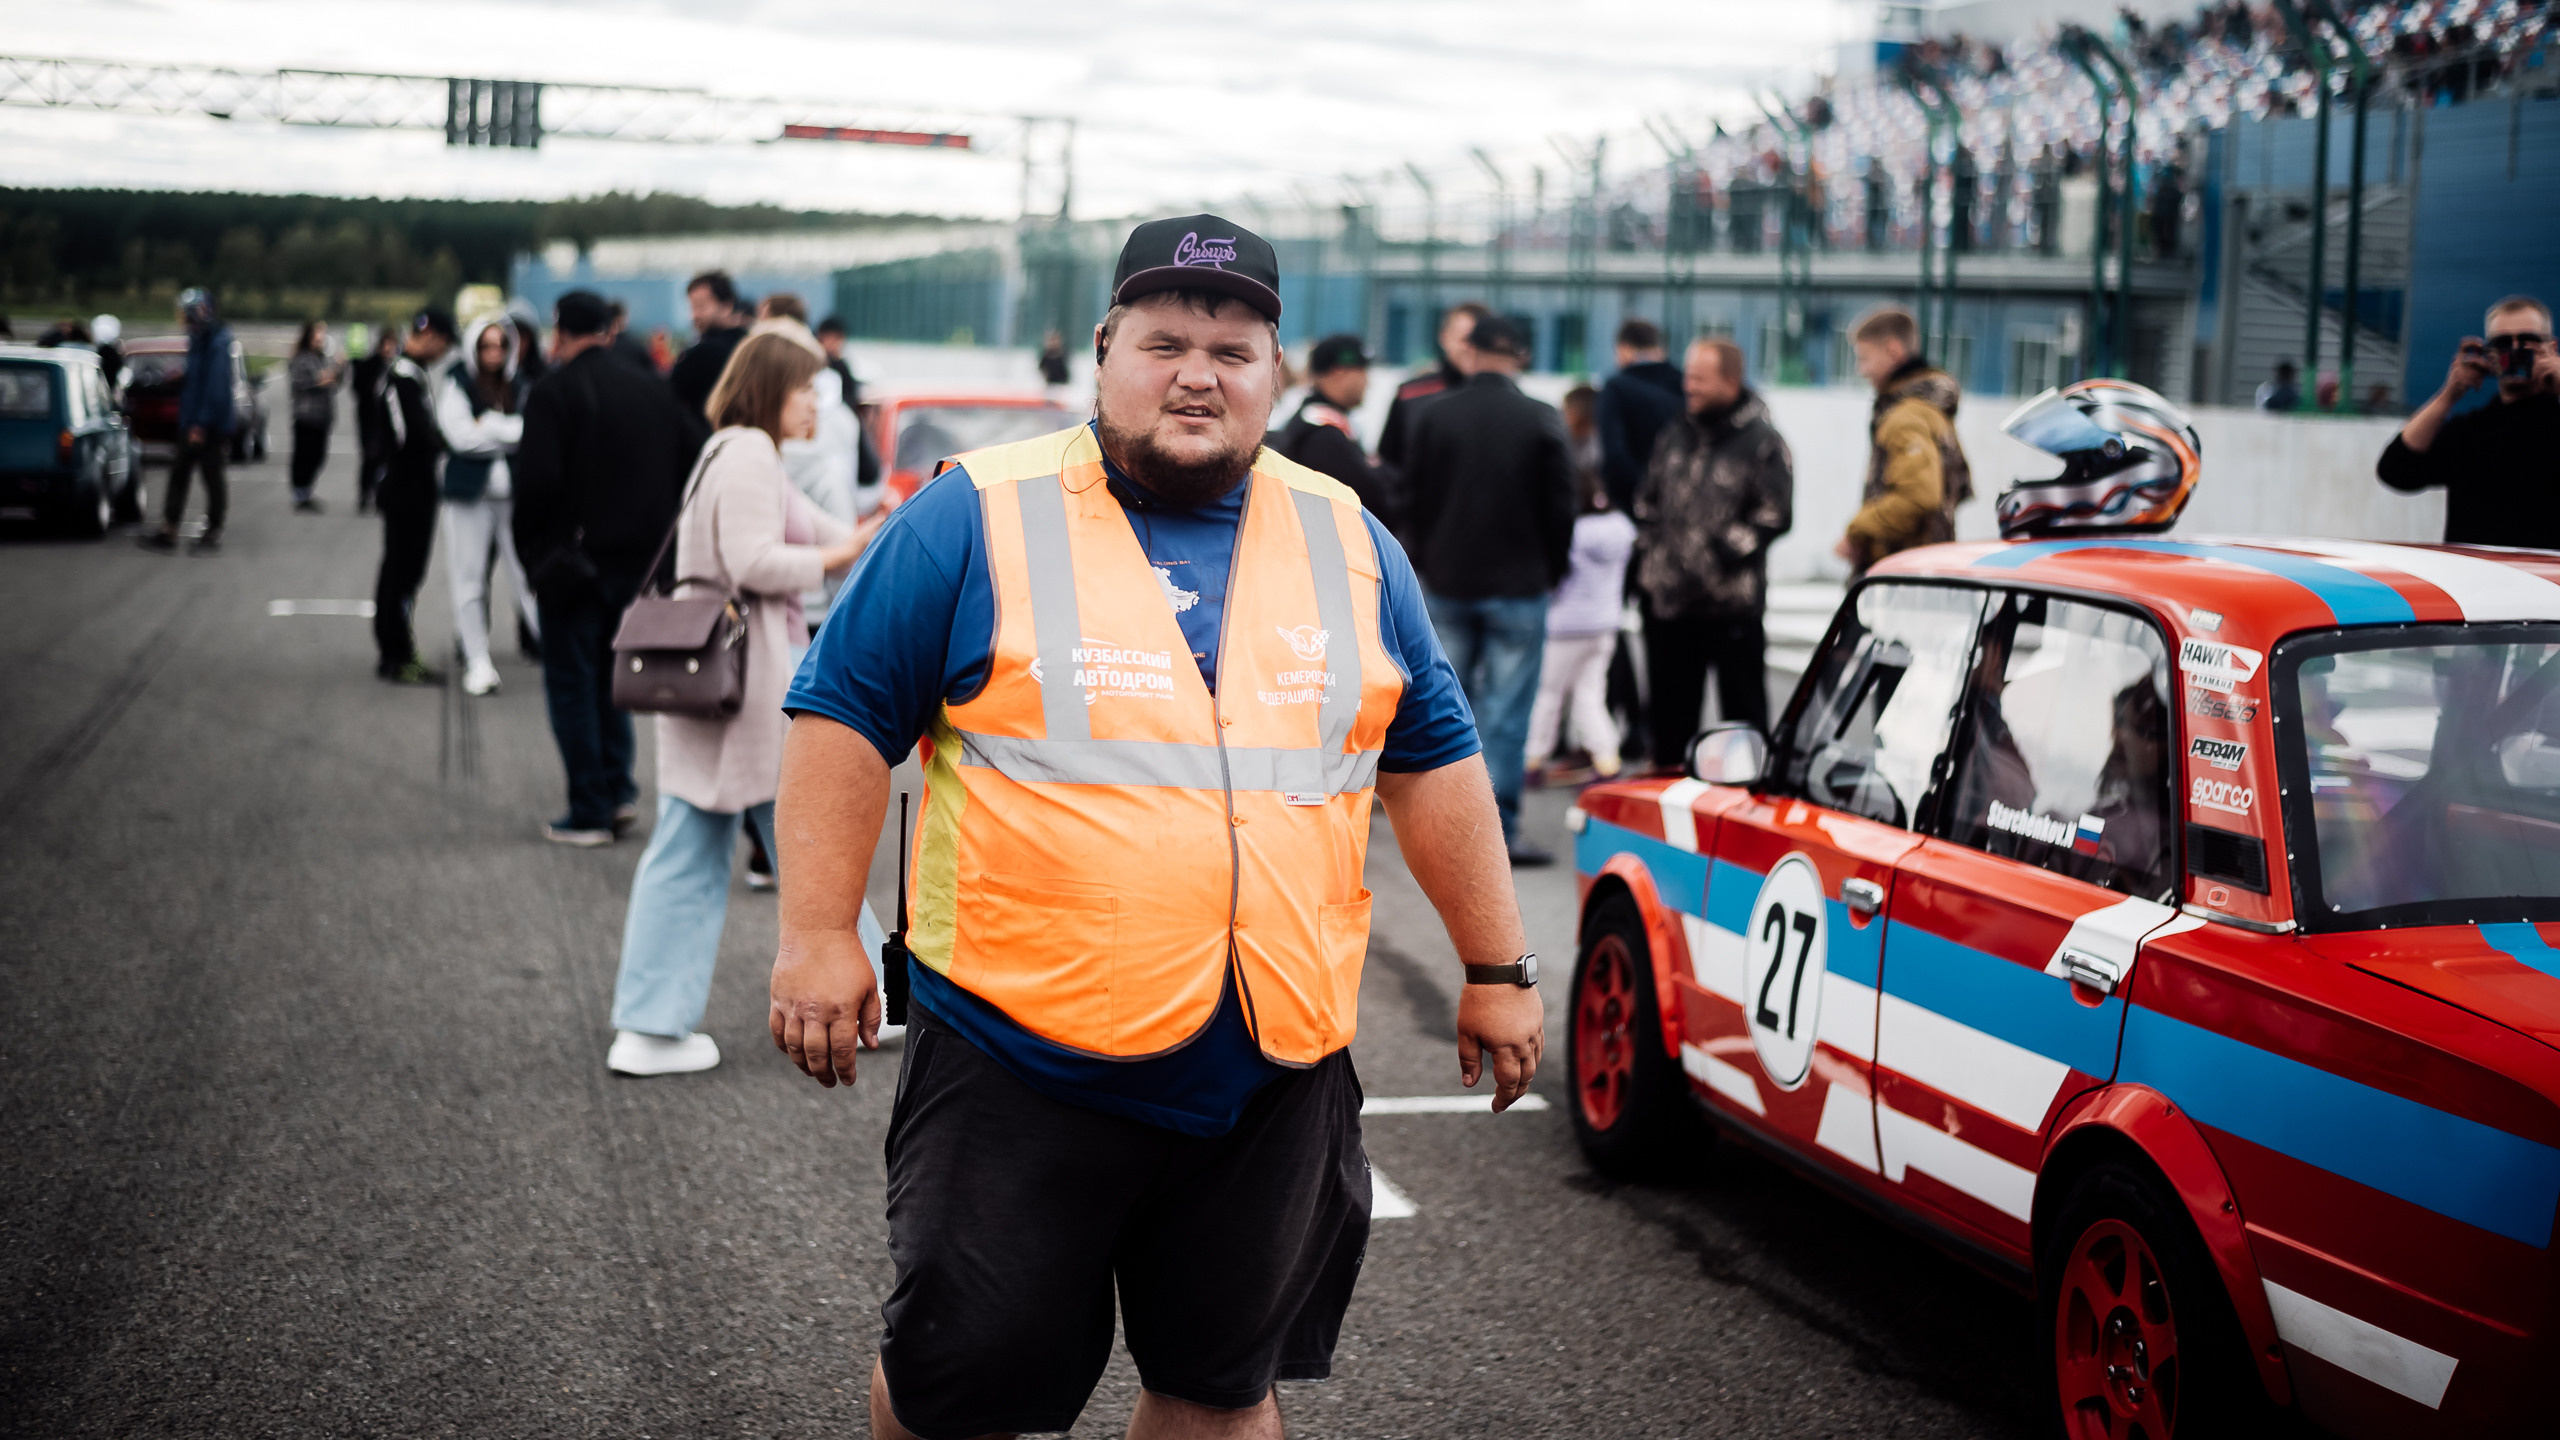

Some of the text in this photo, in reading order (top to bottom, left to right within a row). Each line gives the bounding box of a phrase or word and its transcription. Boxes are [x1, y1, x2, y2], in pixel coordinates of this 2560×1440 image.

[1072, 648, 1172, 670] КУЗБАССКИЙ
[2181, 642, 2229, 668] HAWK
[1073, 665, 1175, 691] АВТОДРОМ
[2199, 675, 2232, 690] YAMAHA
[1101, 689, 1154, 698] MOTORSPORT
[2191, 776, 2254, 811] sparco
[1756, 902, 1817, 1041] 27
